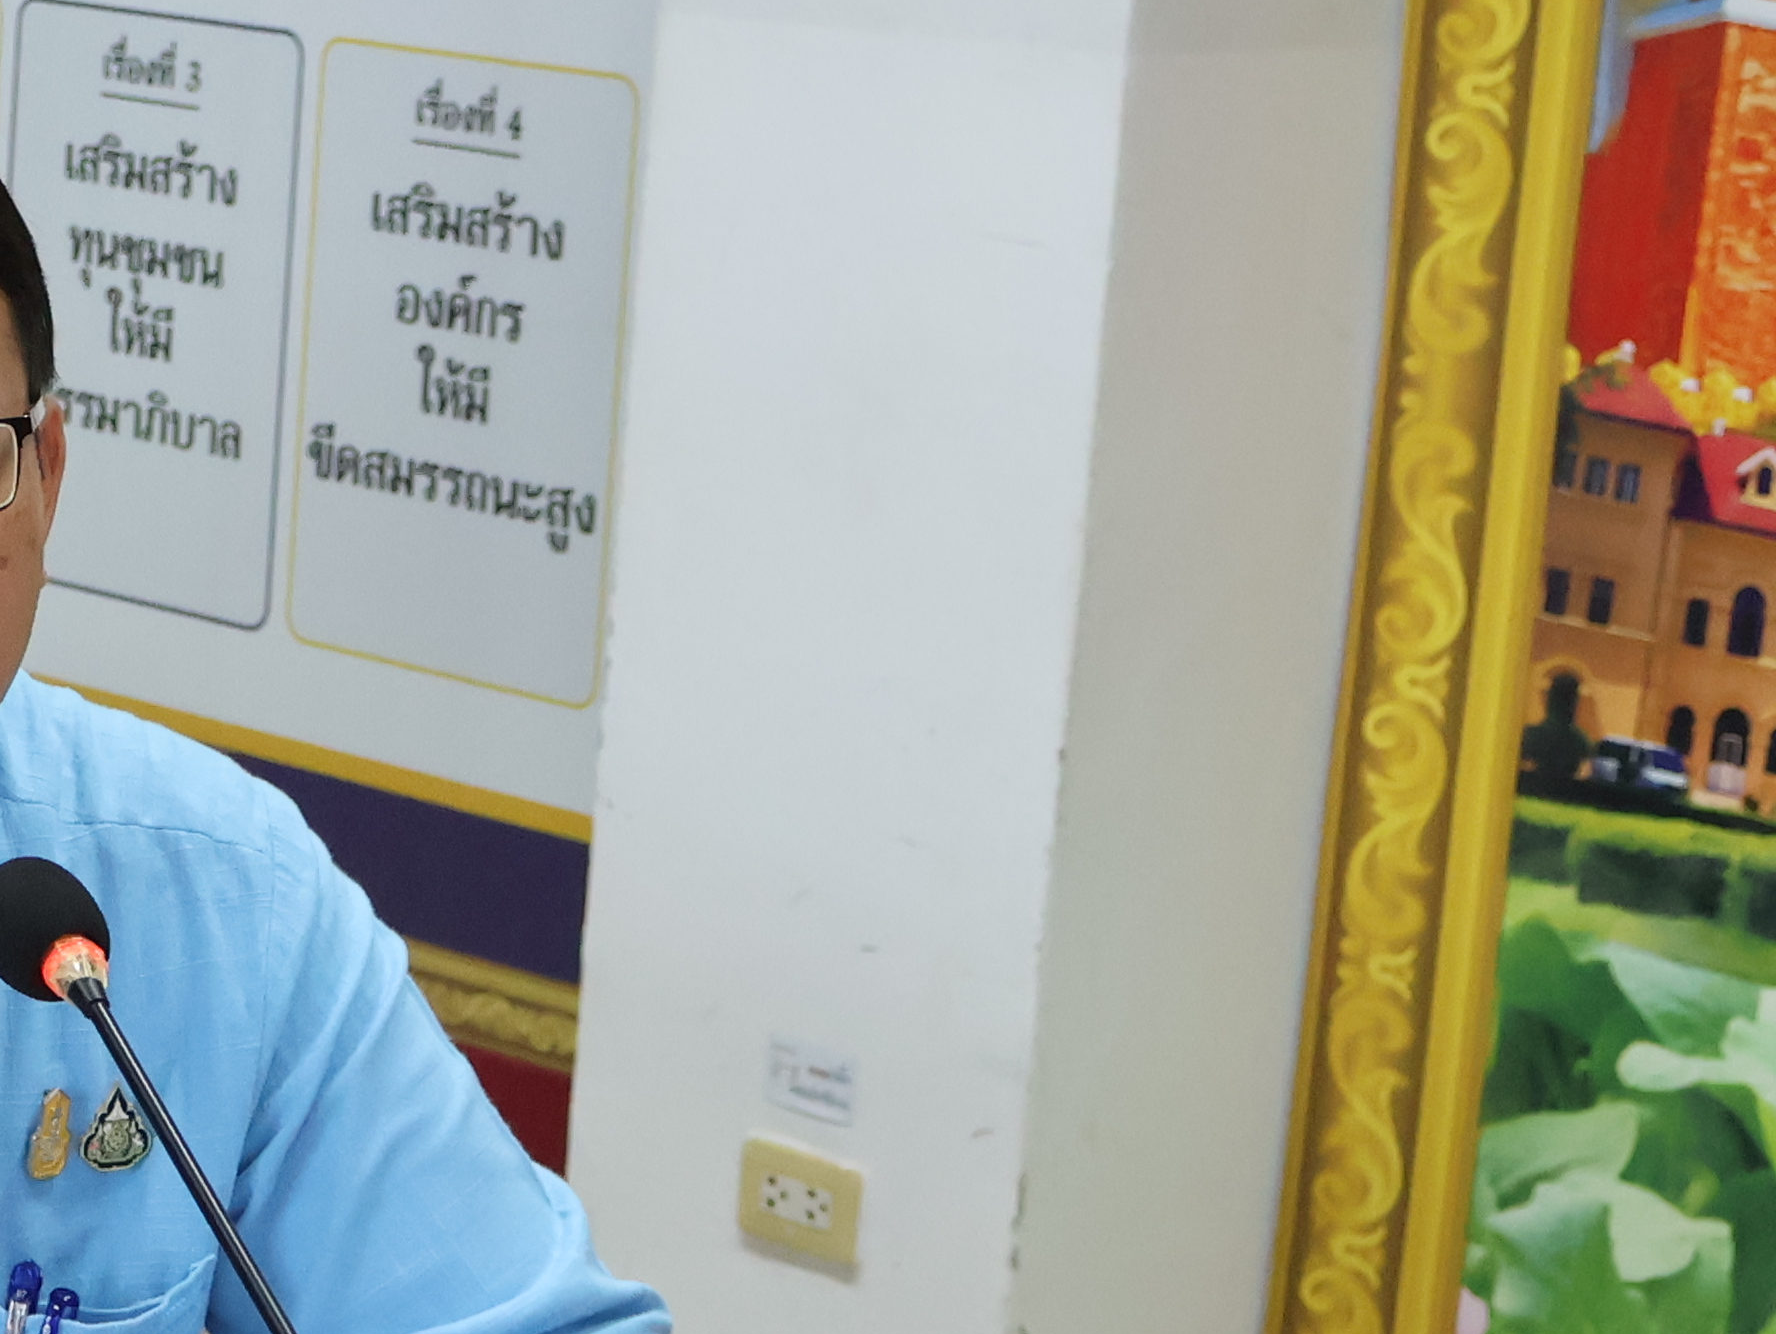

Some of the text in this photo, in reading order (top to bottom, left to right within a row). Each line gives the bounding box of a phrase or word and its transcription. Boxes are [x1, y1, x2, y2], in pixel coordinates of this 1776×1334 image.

[102, 36, 203, 92] เรื่องที่ 3
[414, 78, 524, 141] เรื่องที่ 4
[63, 133, 239, 207] เสริมสร้าง
[370, 182, 565, 262] เสริมสร้าง
[69, 225, 225, 296] ทุนชุมชน
[104, 285, 175, 363] ให้มี
[395, 275, 525, 344] องค์กร
[416, 345, 491, 425] ให้มี
[55, 387, 243, 461] รรมาภิบาล
[306, 422, 597, 554] ขีดสมรรถนะสูง
